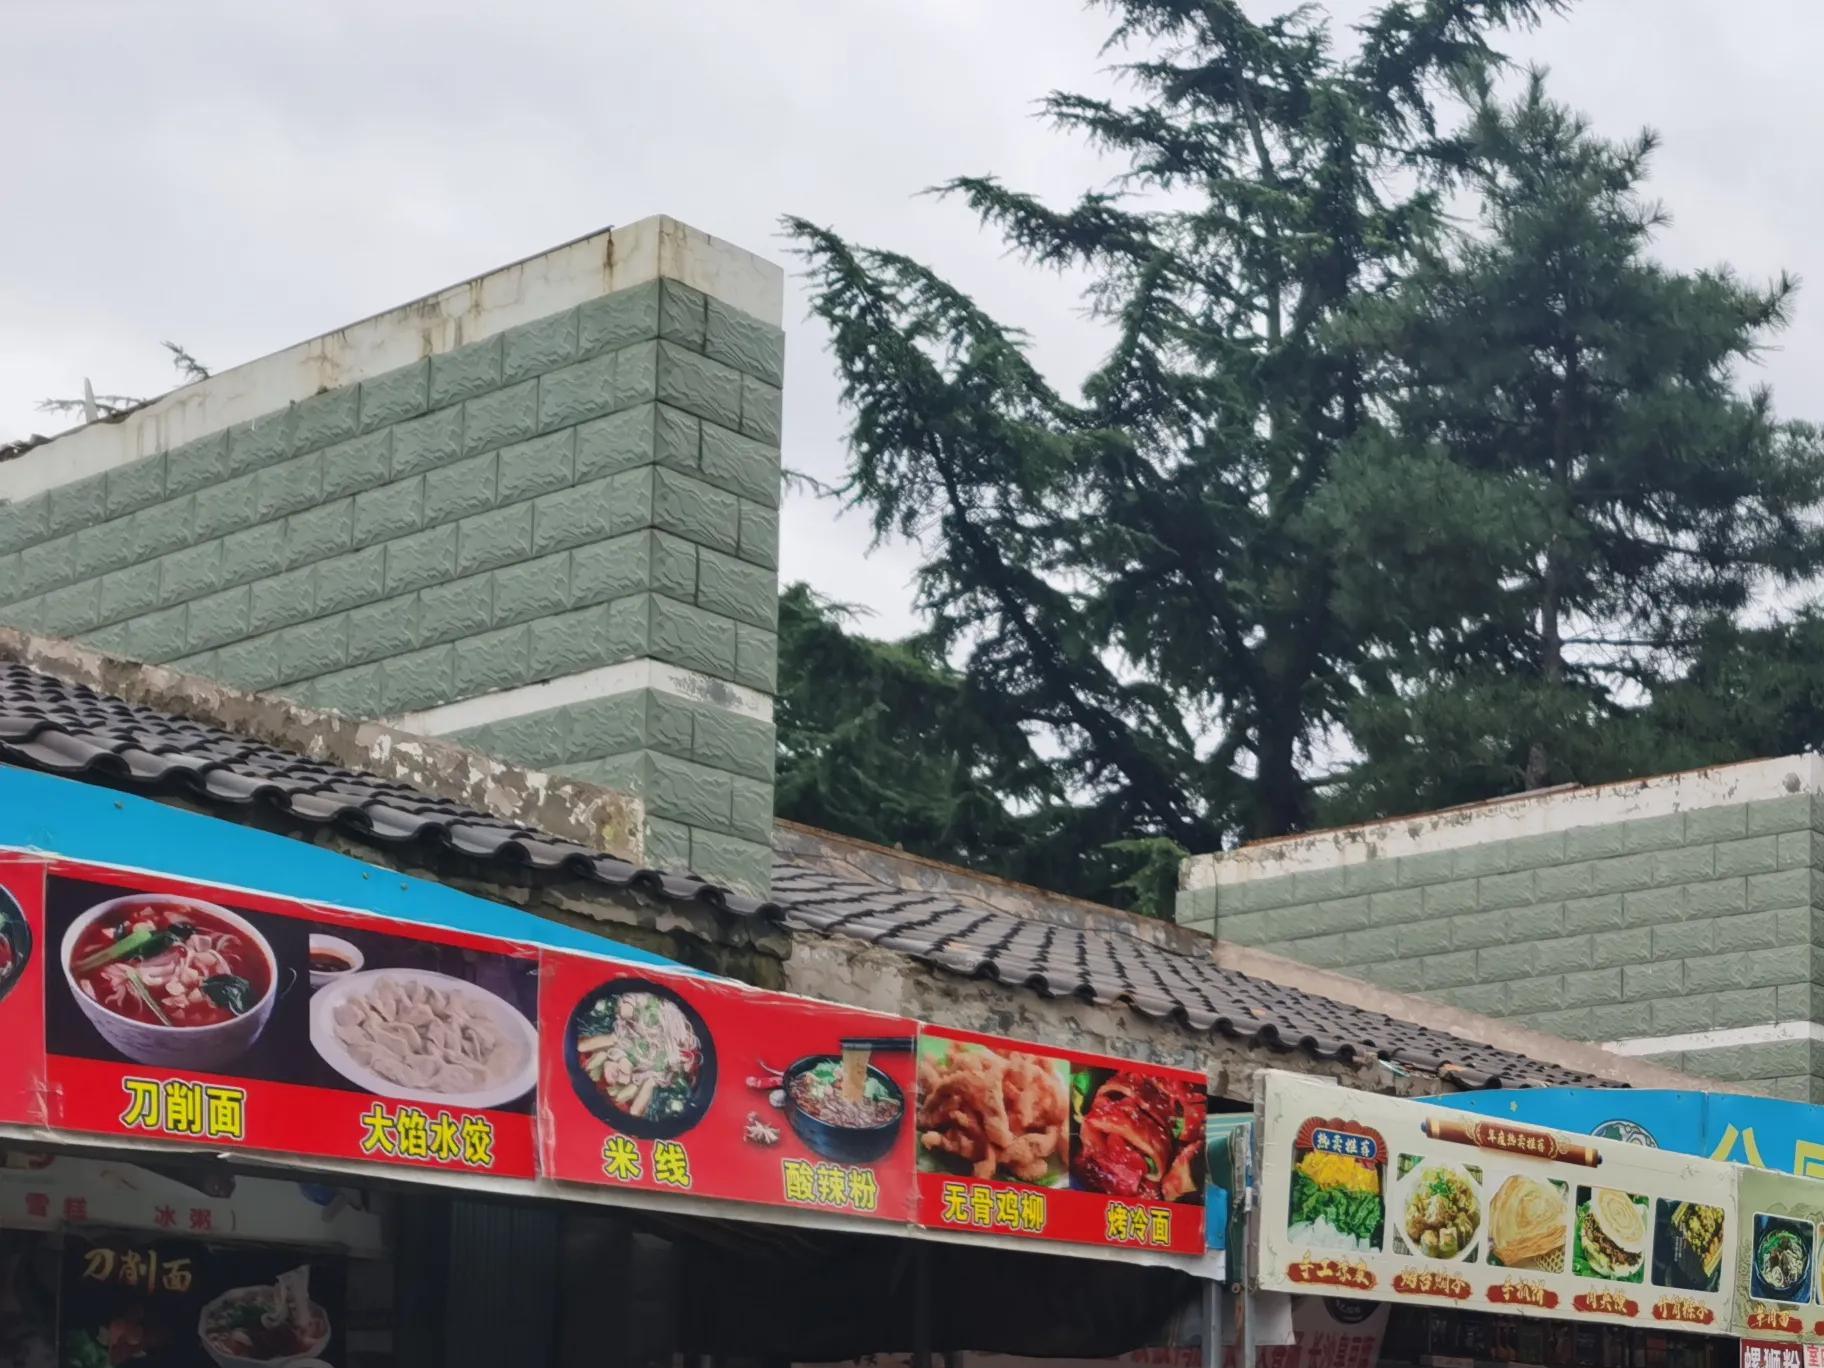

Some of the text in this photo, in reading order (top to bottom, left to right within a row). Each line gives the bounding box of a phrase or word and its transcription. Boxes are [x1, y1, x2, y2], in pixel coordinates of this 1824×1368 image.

[121, 1077, 246, 1139] 刀削面
[361, 1104, 494, 1165] 大馅水饺
[603, 1136, 691, 1187] 米线
[782, 1159, 878, 1211] 酸辣粉
[942, 1183, 1047, 1231] 无骨鸡柳
[1107, 1202, 1171, 1245] 烤冷面
[83, 1248, 193, 1294] 刀削面
